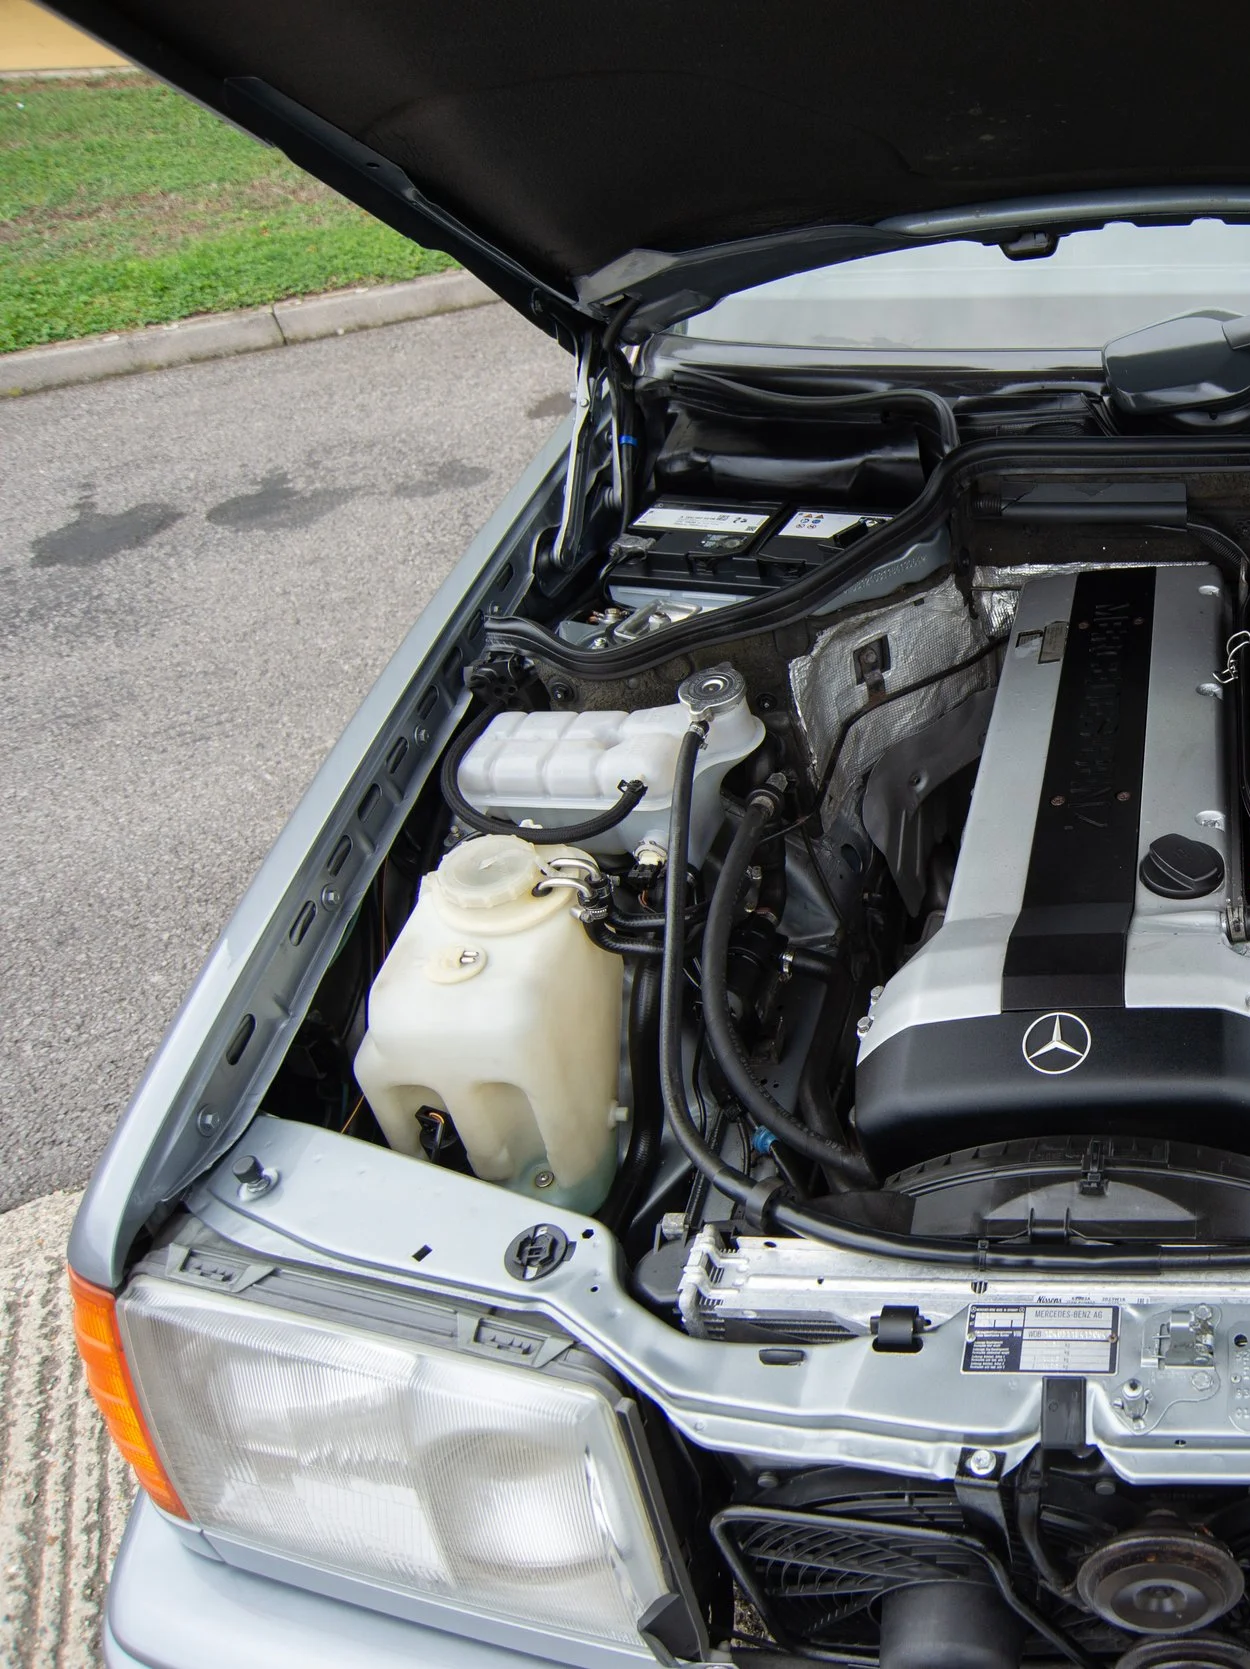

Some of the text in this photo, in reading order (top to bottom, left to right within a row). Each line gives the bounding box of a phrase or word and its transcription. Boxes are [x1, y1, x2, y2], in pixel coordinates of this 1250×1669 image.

[1036, 1295, 1062, 1304] Nissens
[1034, 1309, 1103, 1319] MERCEDES-BENZ AG
[1028, 1330, 1042, 1339] WDB
